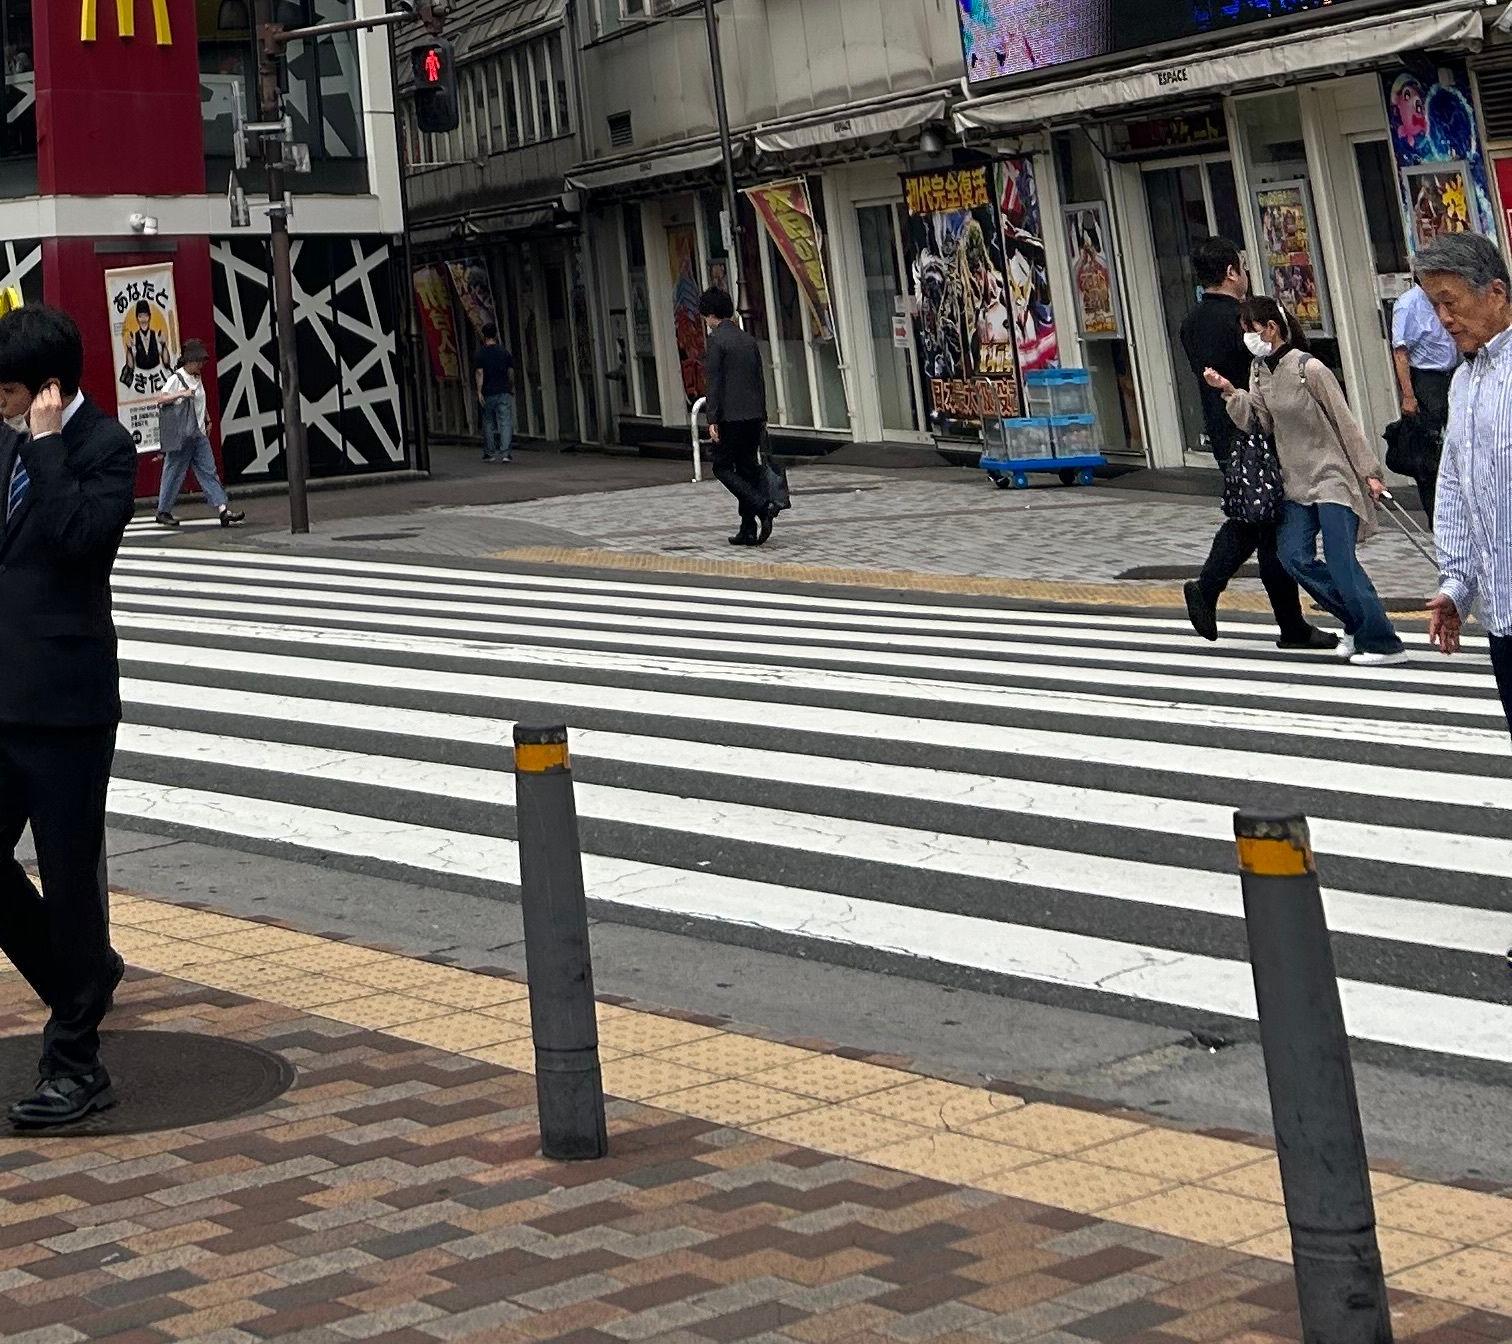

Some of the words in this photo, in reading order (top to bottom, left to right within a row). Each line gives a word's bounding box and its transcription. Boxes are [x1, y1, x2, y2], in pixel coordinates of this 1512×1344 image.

[1157, 68, 1188, 86] ESPACE
[113, 279, 169, 314] あなたと
